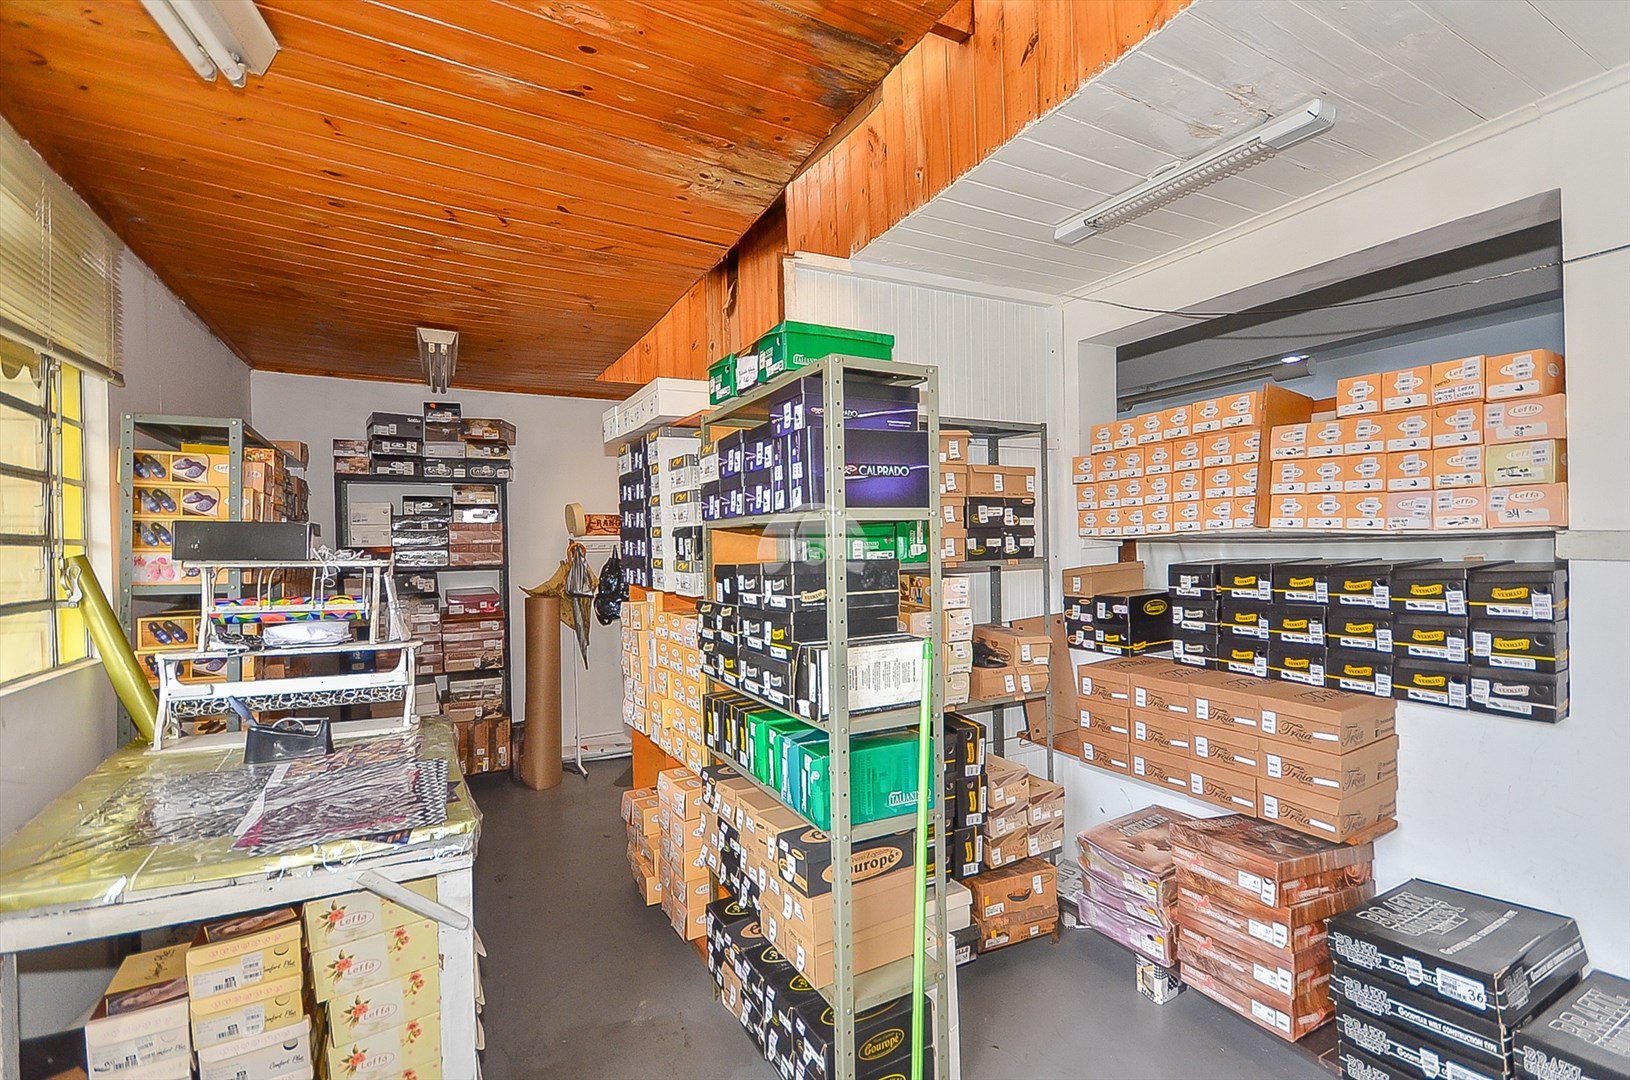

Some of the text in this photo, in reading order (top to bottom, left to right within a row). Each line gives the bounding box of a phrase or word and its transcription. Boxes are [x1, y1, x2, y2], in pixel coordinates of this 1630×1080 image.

[1511, 406, 1538, 414] Leffa
[859, 465, 910, 476] CALPRADO
[1092, 684, 1112, 700] Troia
[1146, 695, 1169, 711] Troia
[1090, 716, 1111, 732] Troia
[1209, 707, 1235, 725] Troia
[1146, 729, 1170, 747] Troia
[1278, 720, 1313, 742] Troia
[1094, 750, 1111, 765] Troia
[1209, 744, 1235, 763] Troia
[1145, 764, 1169, 782] Troia
[1281, 762, 1314, 784] Troia
[1204, 781, 1232, 801] Troia
[1278, 803, 1311, 826] Troia
[851, 850, 895, 873] uropé
[340, 914, 367, 927] Leffa
[347, 962, 375, 976] Leffa
[1467, 989, 1484, 1003] 36
[363, 1006, 391, 1020] Leffa
[269, 1058, 291, 1070] Comfort
[361, 1055, 388, 1069] Leffa
